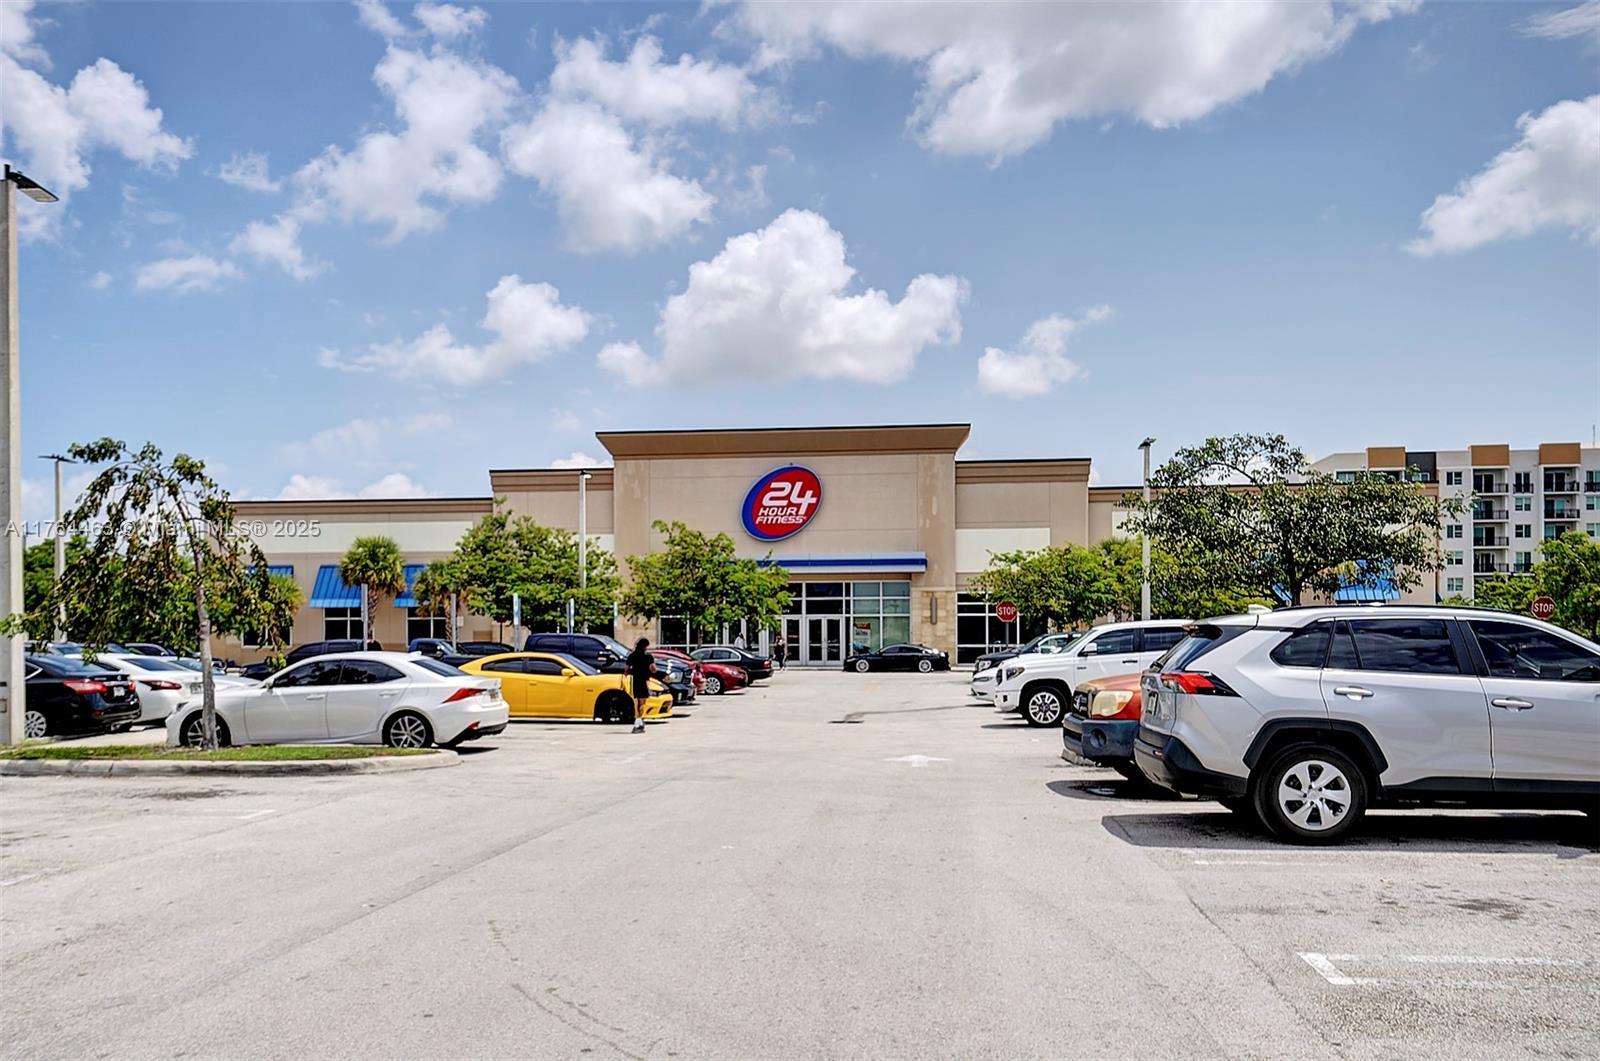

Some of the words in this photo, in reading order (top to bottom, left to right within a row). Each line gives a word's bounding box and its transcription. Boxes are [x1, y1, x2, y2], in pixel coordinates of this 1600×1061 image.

[762, 481, 818, 515] 24
[758, 506, 798, 516] HOUR
[755, 515, 804, 525] FITNESS
[998, 606, 1016, 616] STOP
[1533, 602, 1555, 613] STOP
